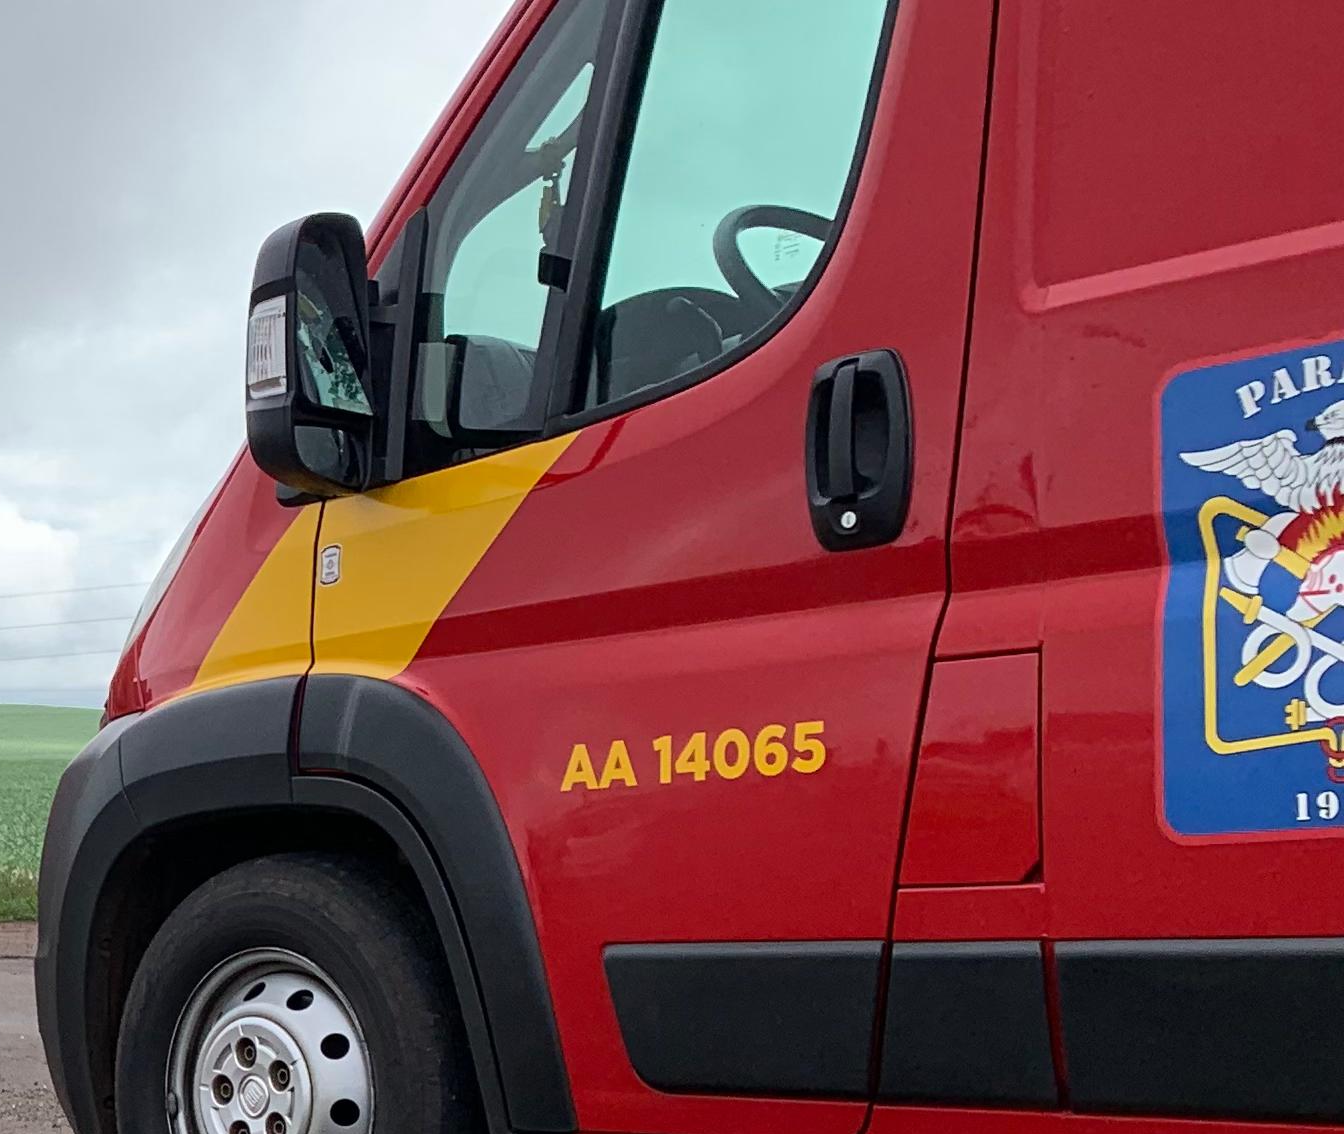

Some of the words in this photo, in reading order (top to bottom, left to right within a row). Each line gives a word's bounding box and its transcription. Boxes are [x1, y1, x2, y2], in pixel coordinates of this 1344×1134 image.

[1235, 356, 1344, 419] PAR
[560, 740, 638, 792] AA
[652, 720, 826, 784] 14065
[1296, 791, 1340, 821] 19
